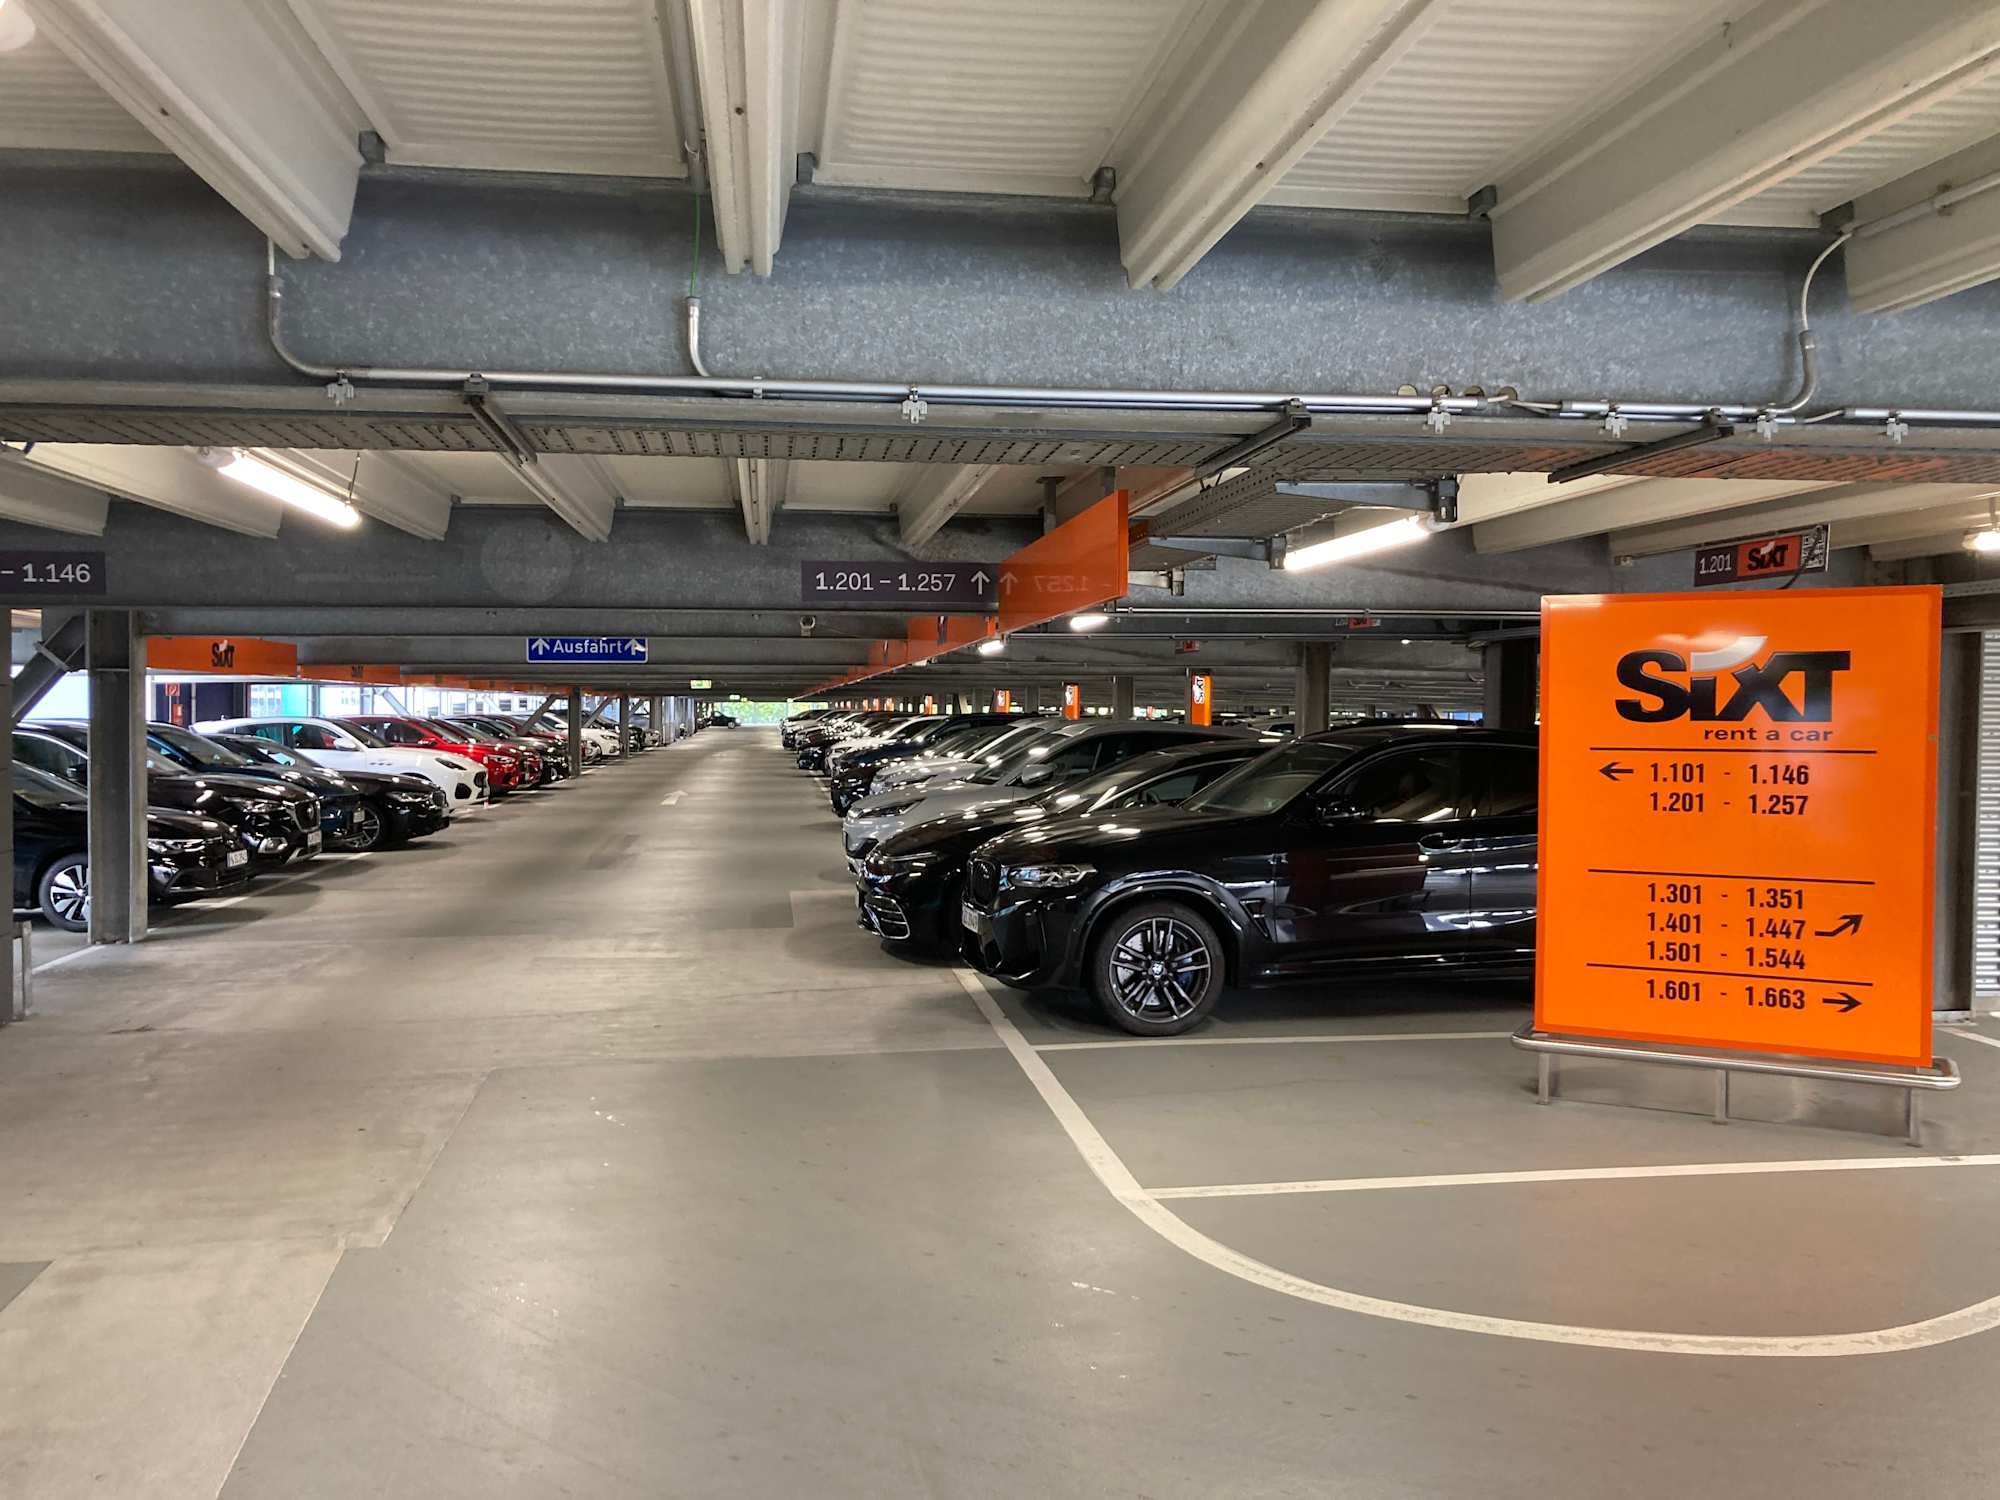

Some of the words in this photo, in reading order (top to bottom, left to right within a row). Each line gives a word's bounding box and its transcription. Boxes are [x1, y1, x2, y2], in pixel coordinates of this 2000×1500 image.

[1699, 553, 1732, 574] 1.201
[1747, 541, 1789, 571] SIXT
[22, 563, 91, 583] 1.146
[815, 572, 874, 591] 1.201
[898, 573, 957, 592] 1.257
[552, 639, 623, 654] Ausfahrt
[1615, 635, 1851, 723] SIXT
[1704, 727, 1757, 741] rent
[1765, 730, 1780, 741] a
[1790, 729, 1833, 742] car
[1650, 763, 1705, 783] 1.101
[1748, 764, 1809, 785] 1.146
[1650, 792, 1704, 813] 1.201
[1748, 795, 1809, 815] 1.257
[1648, 883, 1702, 905] 1.301
[1746, 888, 1804, 910] 1.351
[1648, 912, 1702, 934] 1.401
[1746, 917, 1806, 940] 1.447
[1647, 941, 1701, 963] 1.501
[1745, 947, 1806, 970] 1.544
[1646, 979, 1700, 1002] 1.601
[1745, 986, 1805, 1010] 1.663
